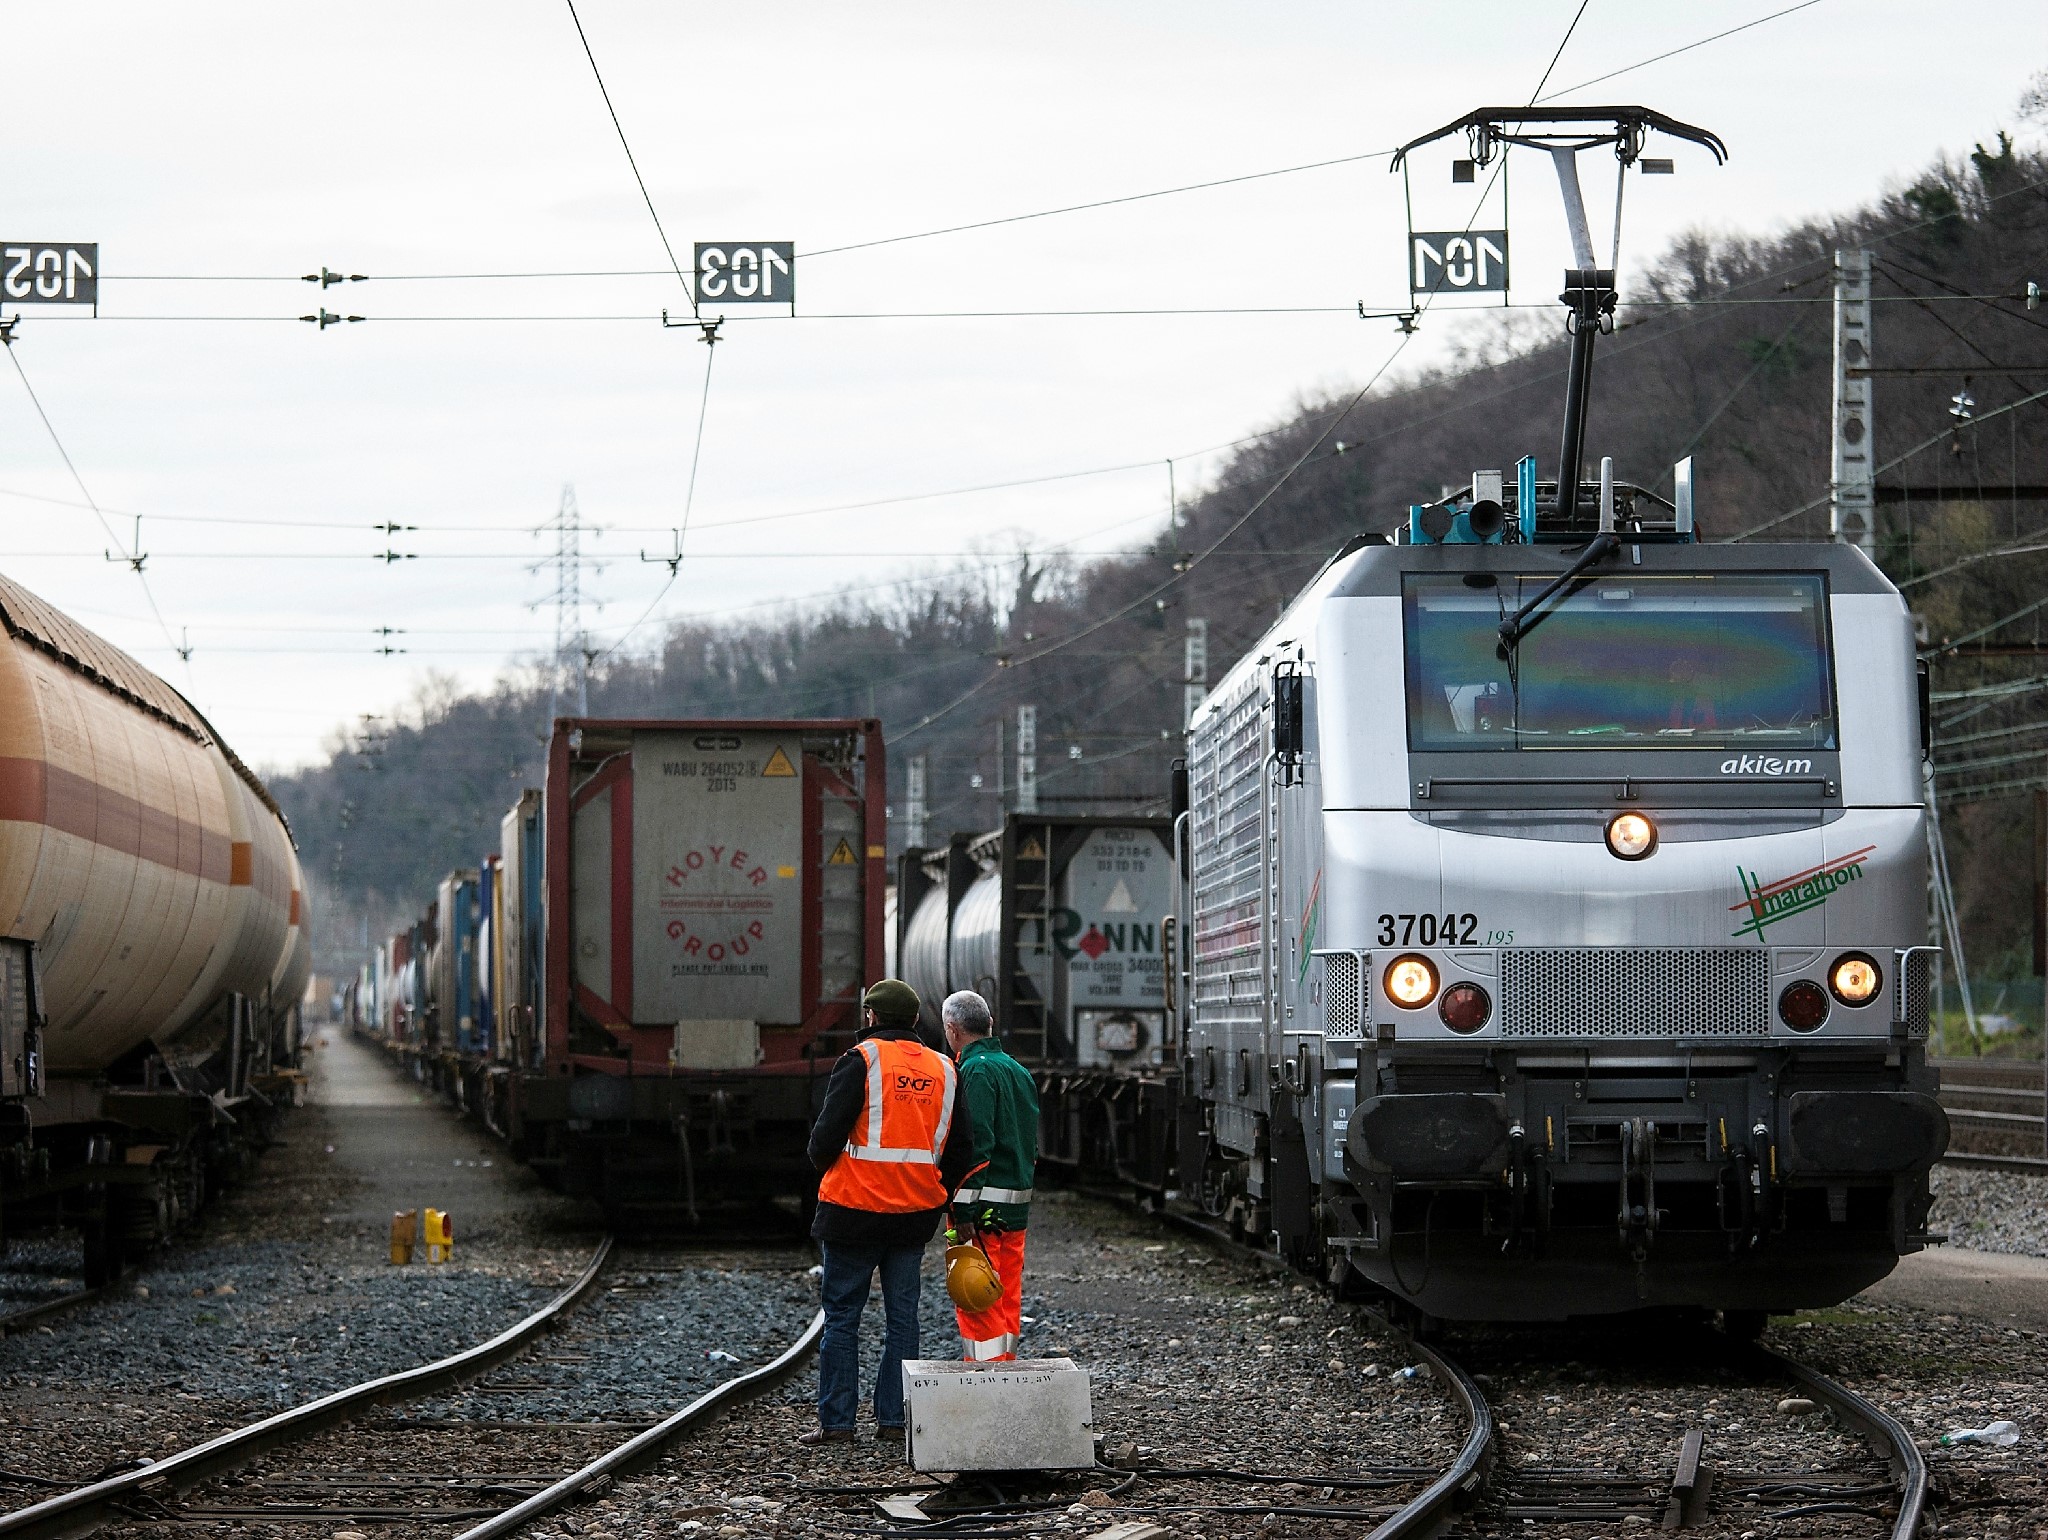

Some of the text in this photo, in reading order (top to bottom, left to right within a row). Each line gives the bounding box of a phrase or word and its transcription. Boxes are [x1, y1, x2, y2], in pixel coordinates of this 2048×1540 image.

[663, 761, 697, 777] WABU
[1720, 754, 1812, 776] akiem
[666, 844, 768, 888] HOYER
[1764, 862, 1863, 914] marathon
[667, 920, 763, 961] GROUP
[1377, 913, 1478, 946] 37042
[897, 1076, 932, 1091] SNCF
